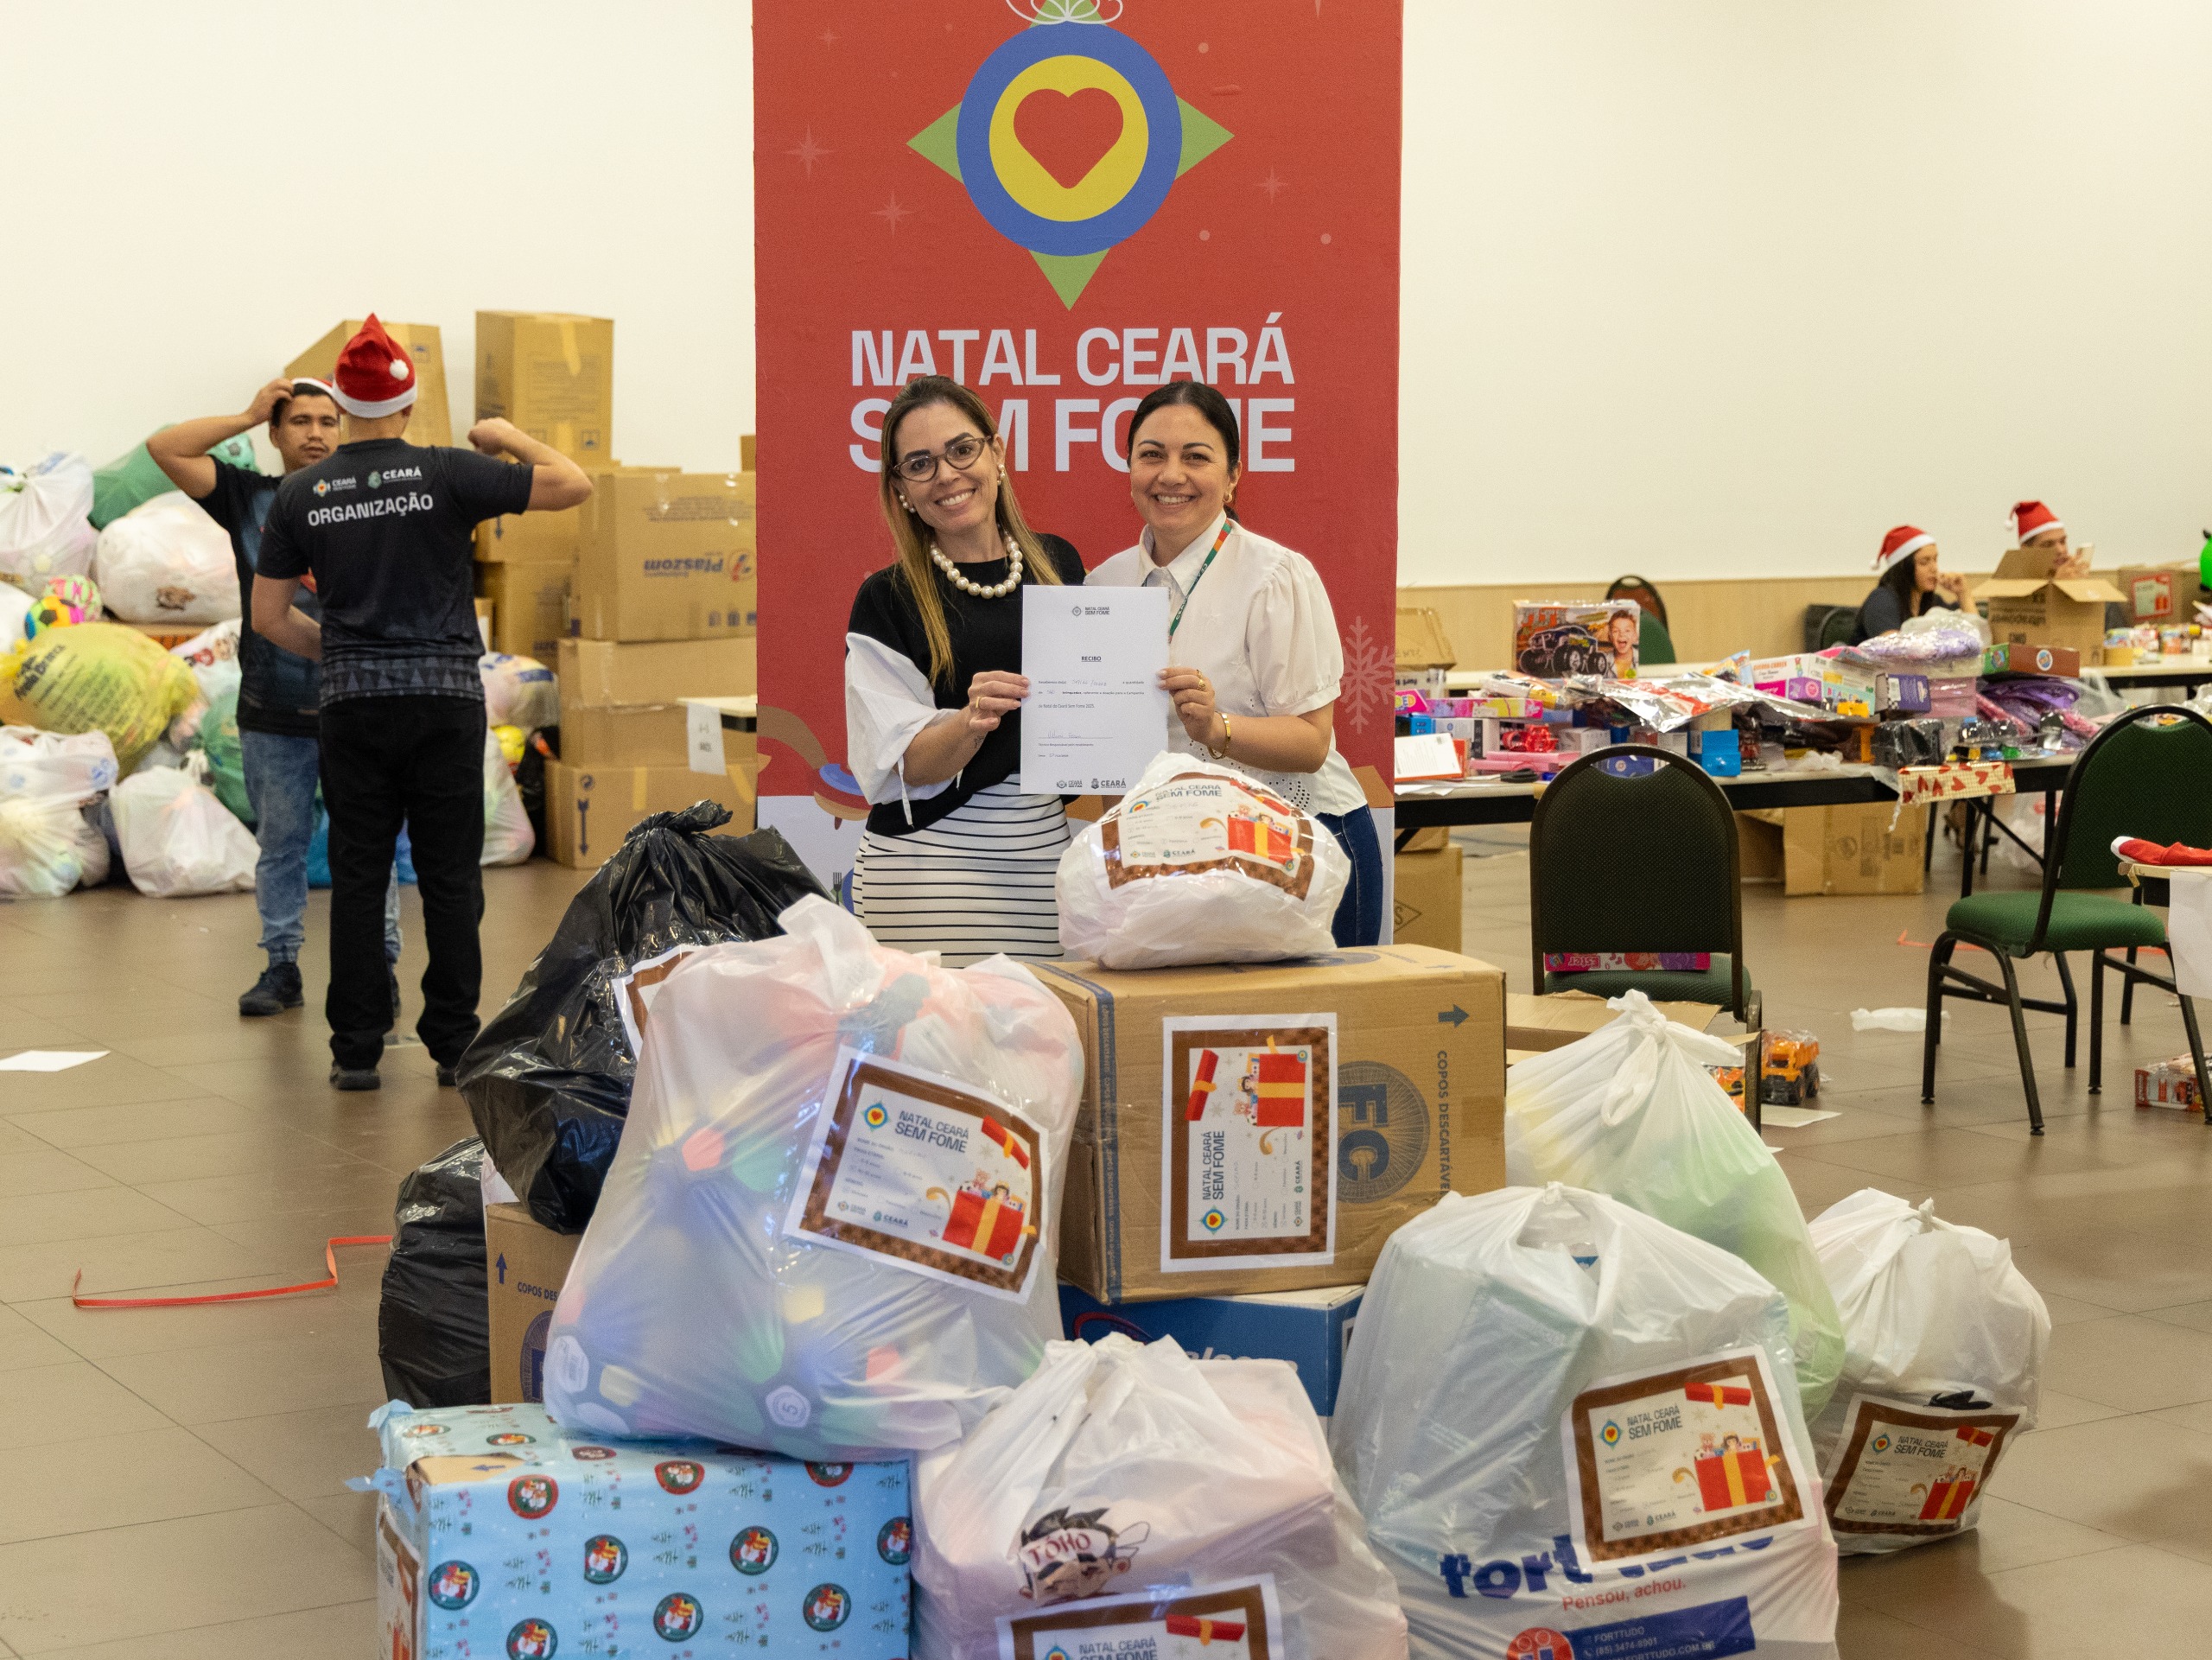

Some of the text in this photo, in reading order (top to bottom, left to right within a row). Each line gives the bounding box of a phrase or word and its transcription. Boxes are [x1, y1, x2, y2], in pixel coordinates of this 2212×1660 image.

[851, 311, 1295, 387] NATAL CEARÁ
[383, 466, 423, 480] CEARÁ
[308, 491, 434, 527] ORGANIZAÇÃO
[1100, 778, 1127, 786] CEARÁ
[1437, 1050, 1449, 1099] COPOS
[894, 1123, 927, 1142] SEM
[928, 1132, 969, 1153] FOME
[898, 1110, 969, 1140] NATAL CEARÁ
[1201, 1131, 1211, 1200] NATAL CEARÁ
[1212, 1130, 1224, 1200] SEM FOME
[518, 1282, 559, 1301] COPOS DES
[1626, 1404, 1681, 1427] NATAL CEARÁ
[1627, 1415, 1682, 1441] SEM FOME
[1894, 1444, 1947, 1459] SEM FOME
[1897, 1435, 1948, 1448] NATAL CEARÁ
[1562, 1577, 1687, 1612] Pensou, achou.
[1078, 1637, 1156, 1655] NATAL CEARÁ
[1594, 1626, 1645, 1643] FORTTUDO
